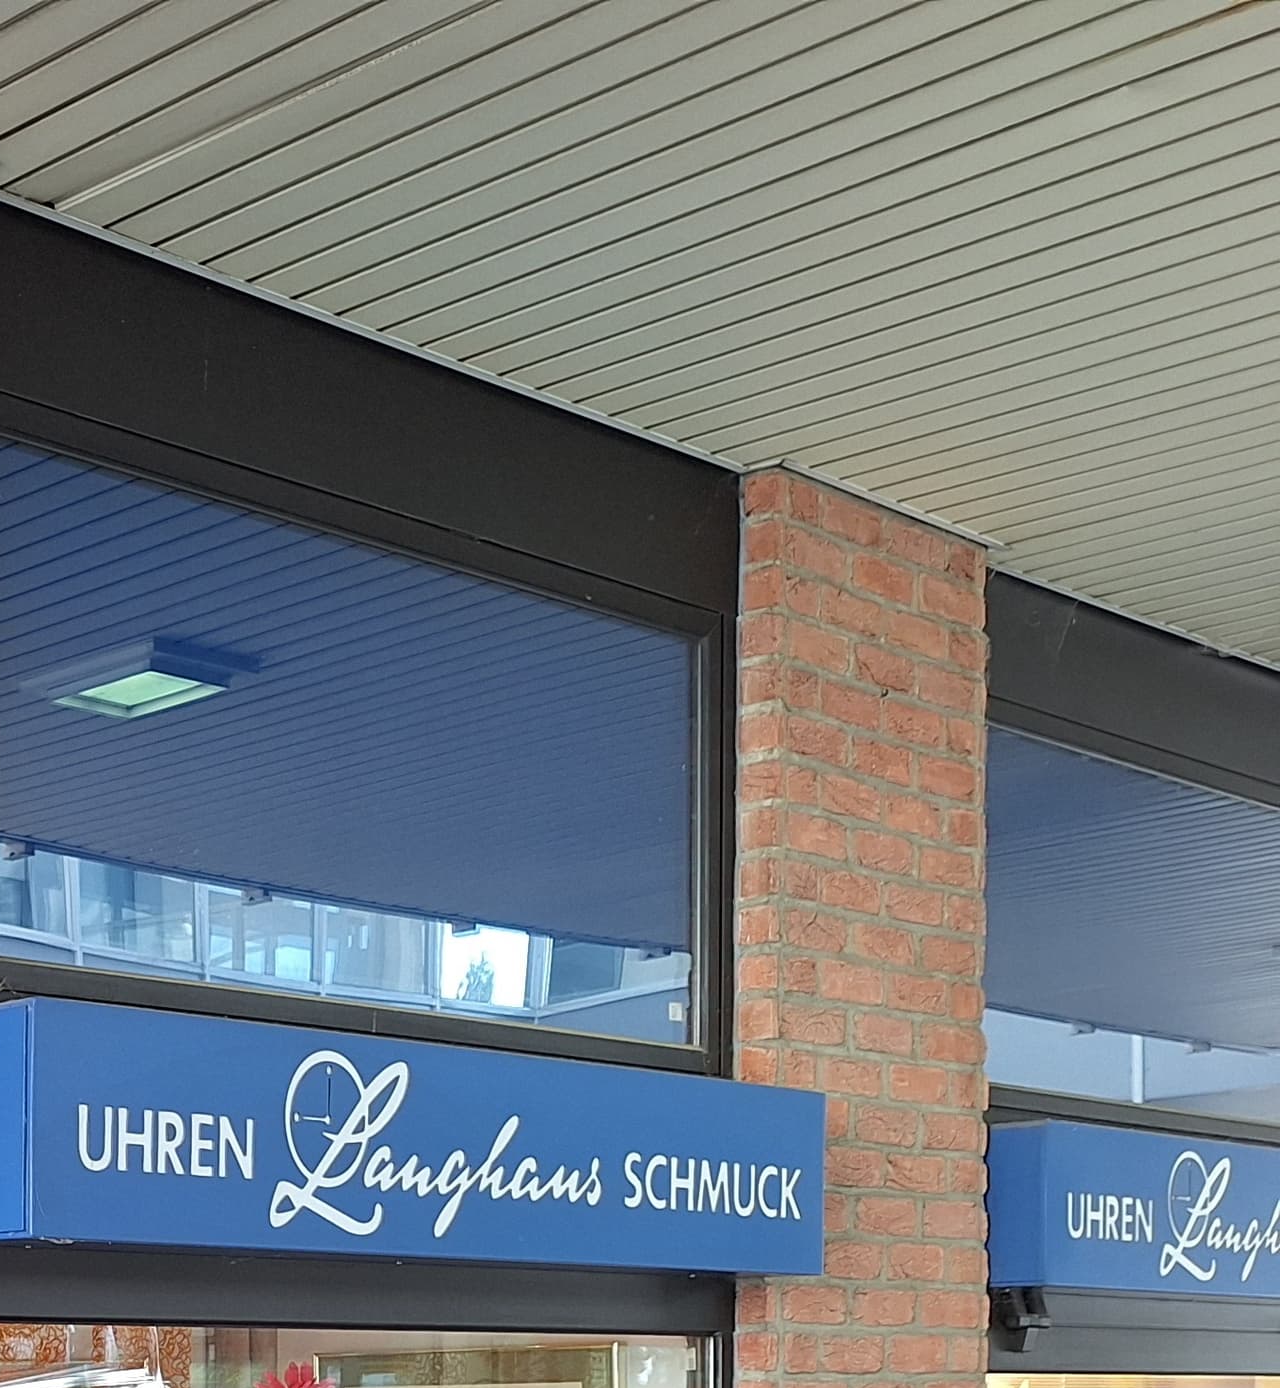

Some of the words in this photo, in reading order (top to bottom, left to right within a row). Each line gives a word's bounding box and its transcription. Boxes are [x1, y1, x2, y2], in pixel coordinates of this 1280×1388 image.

[75, 1103, 255, 1181] UHREN
[623, 1152, 802, 1221] SCHMUCK
[1067, 1191, 1154, 1243] UHREN
